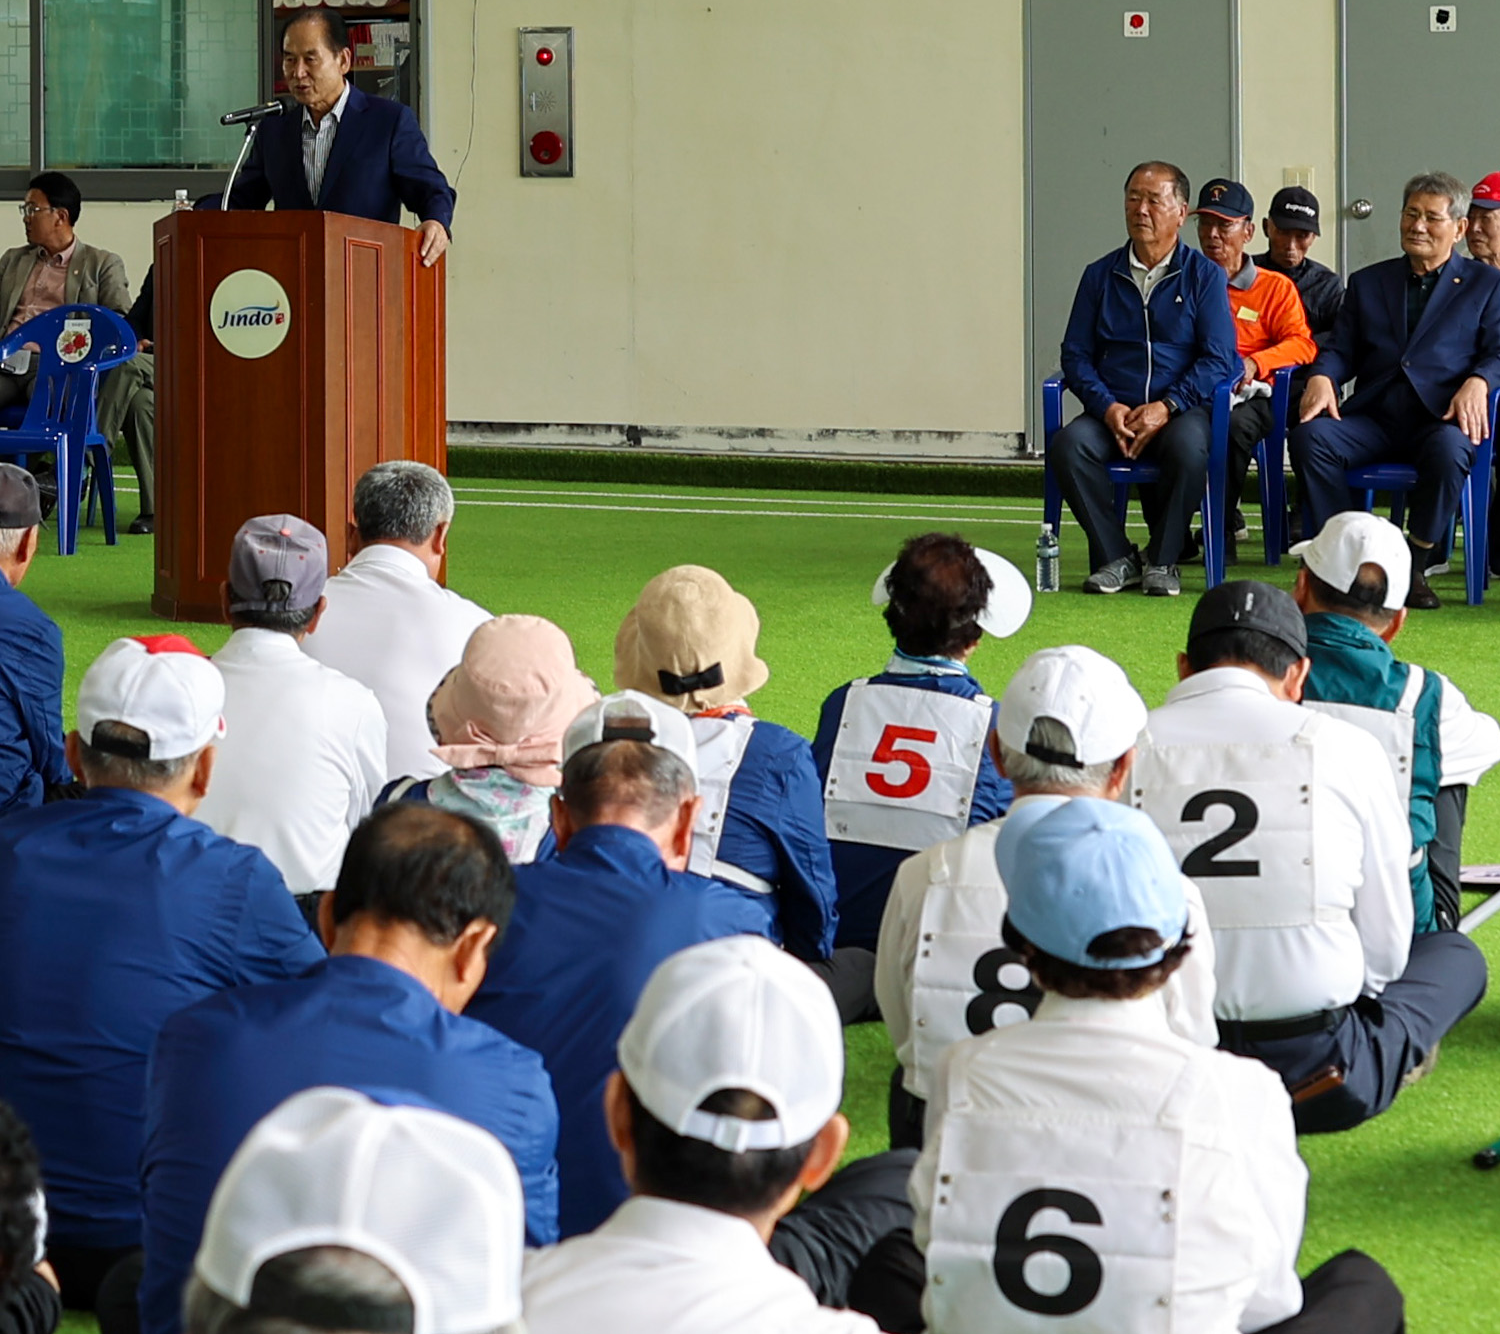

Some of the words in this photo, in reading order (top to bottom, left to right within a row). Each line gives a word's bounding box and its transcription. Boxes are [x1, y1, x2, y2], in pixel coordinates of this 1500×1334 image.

[217, 310, 274, 330] Jindo
[863, 723, 937, 799] 5
[1179, 788, 1261, 878] 2
[965, 946, 1044, 1037] 8
[992, 1186, 1105, 1318] 6
